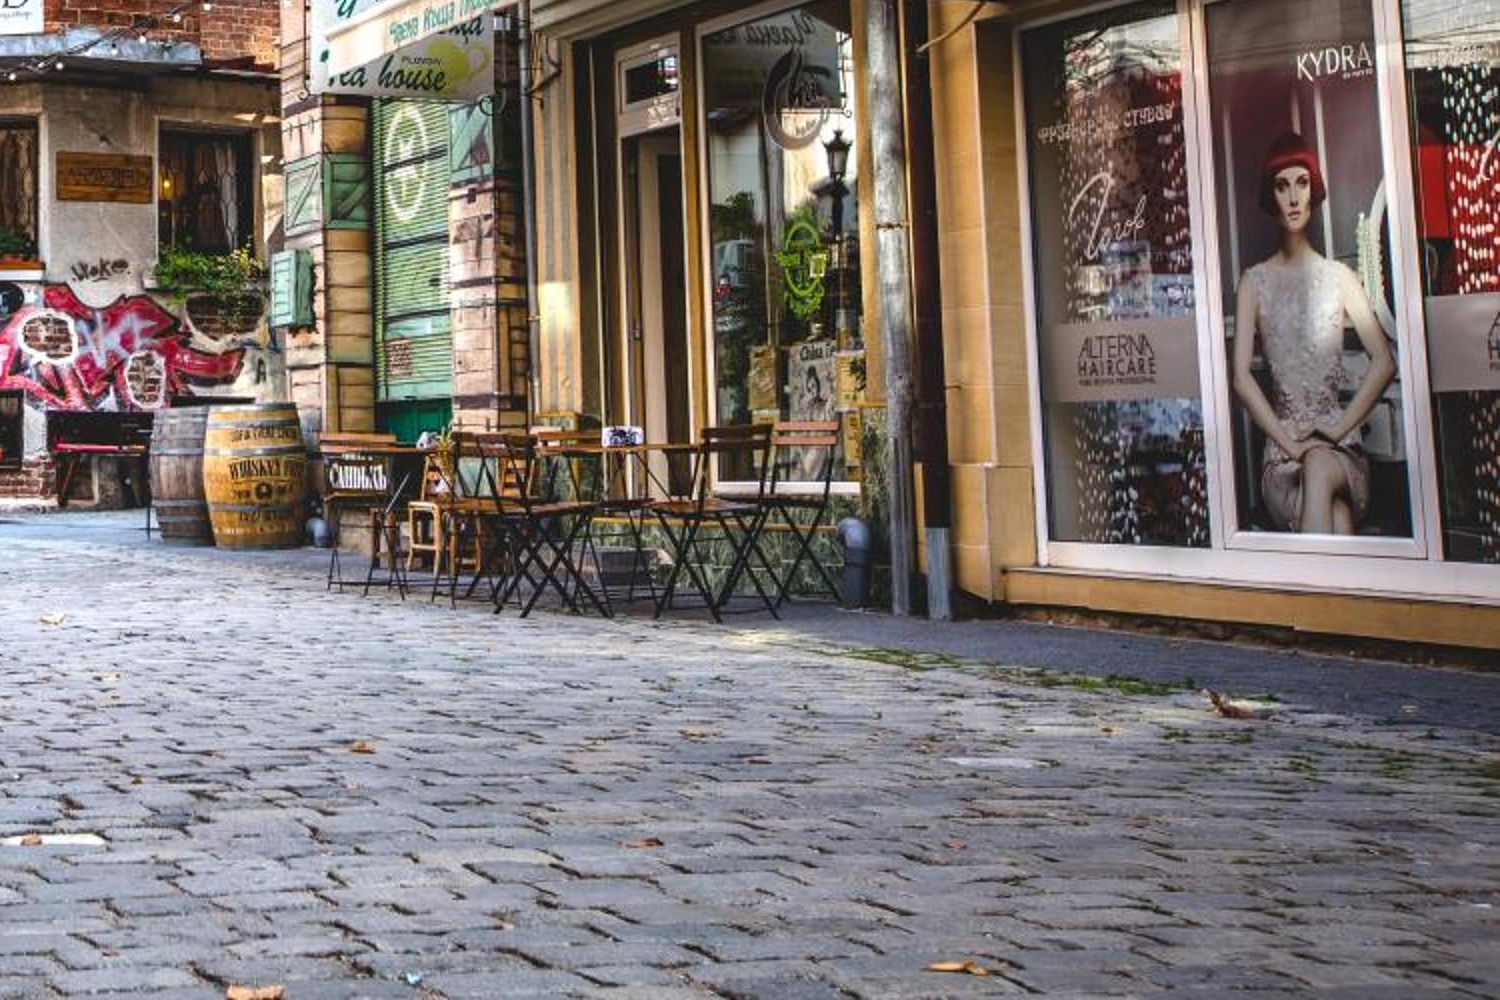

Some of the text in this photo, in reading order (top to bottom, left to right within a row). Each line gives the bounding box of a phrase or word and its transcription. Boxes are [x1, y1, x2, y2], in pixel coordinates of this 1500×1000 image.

[328, 54, 448, 90] ea house
[1296, 41, 1374, 82] KYDRA
[1079, 333, 1155, 358] ALTERNA
[1078, 358, 1157, 376] HAIRCARE
